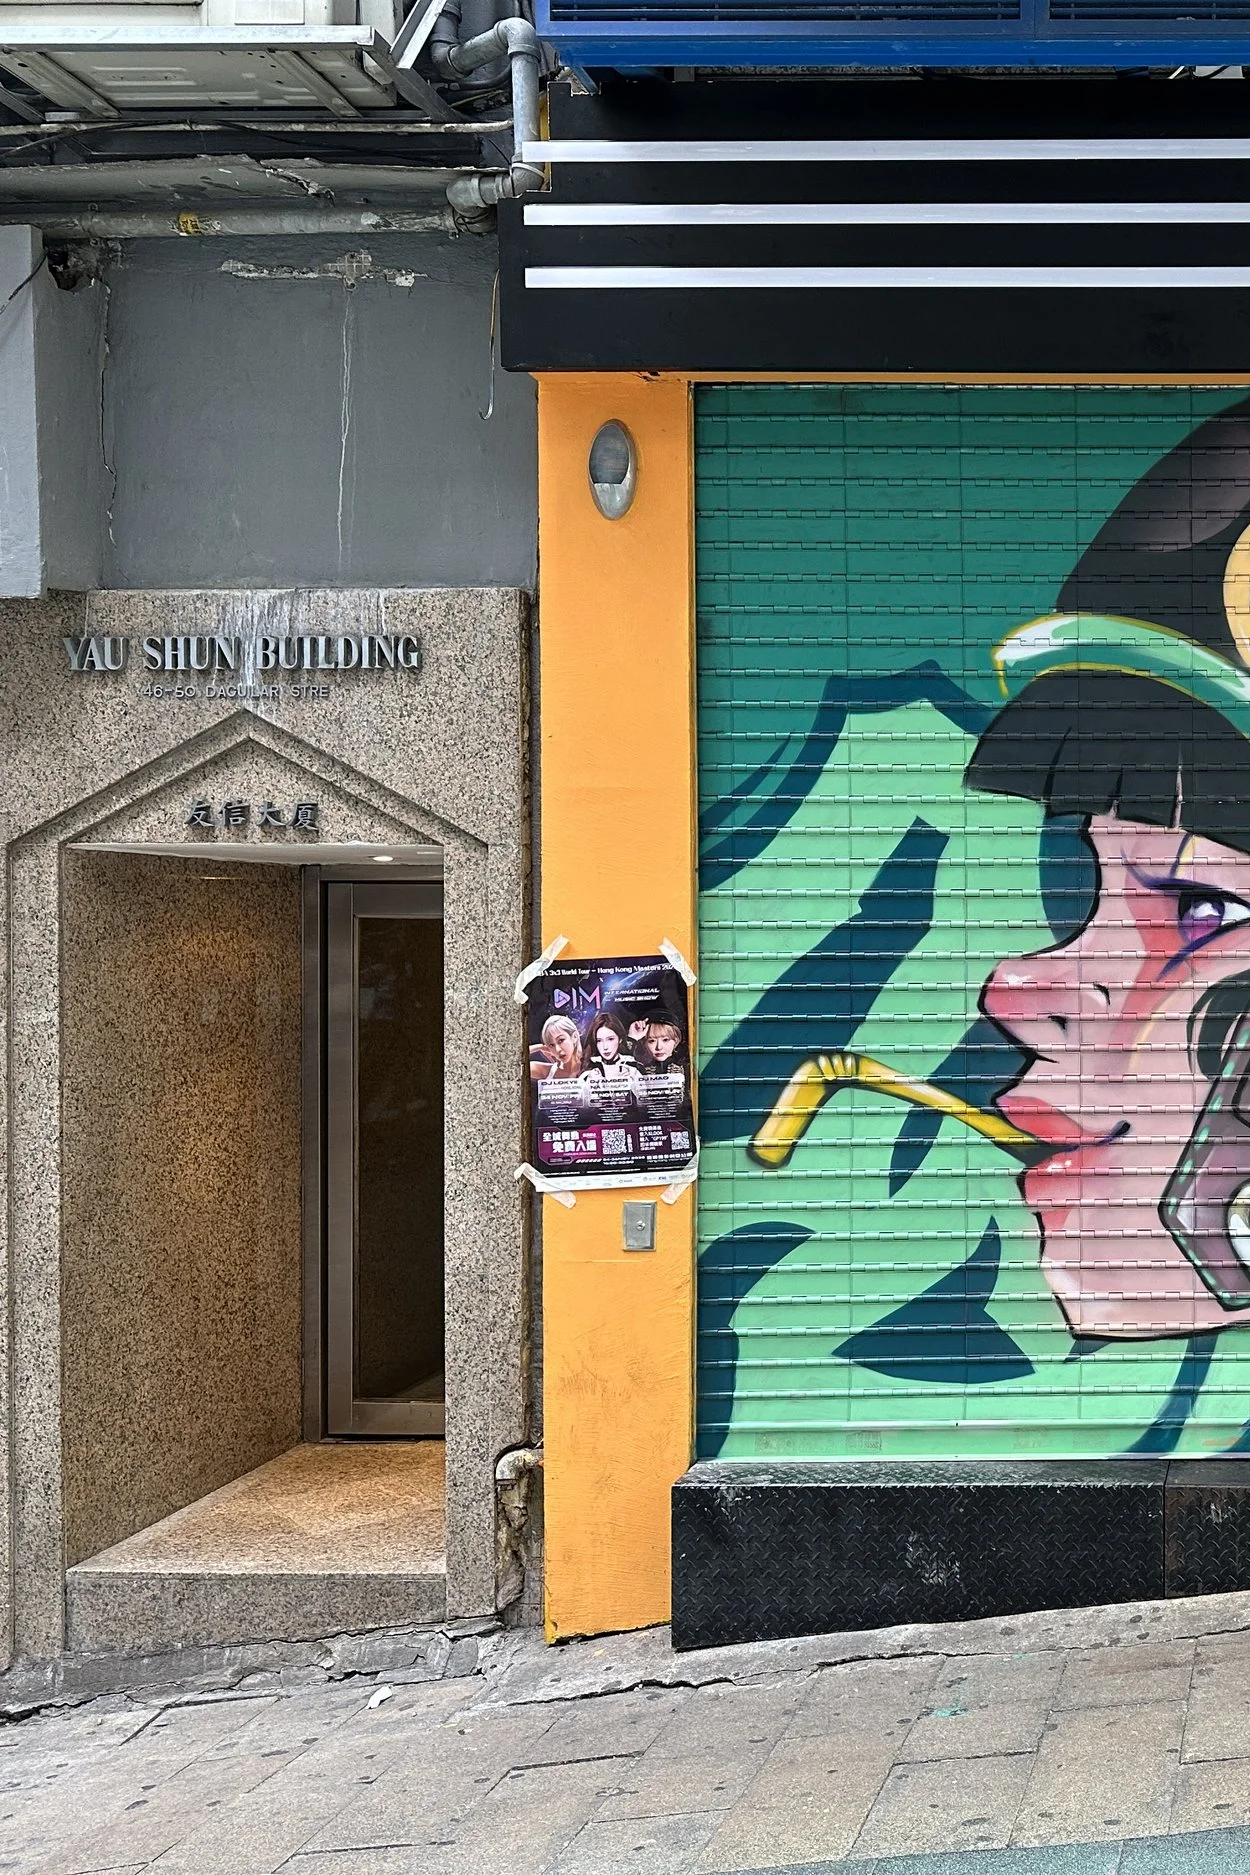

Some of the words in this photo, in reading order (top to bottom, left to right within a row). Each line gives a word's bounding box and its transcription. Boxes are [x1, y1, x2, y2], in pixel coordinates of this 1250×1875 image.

[62, 636, 127, 671] YAU
[142, 636, 237, 670] SHUN
[255, 635, 420, 670] BUILDING
[143, 684, 197, 698] 46-50
[291, 685, 329, 698] STRE
